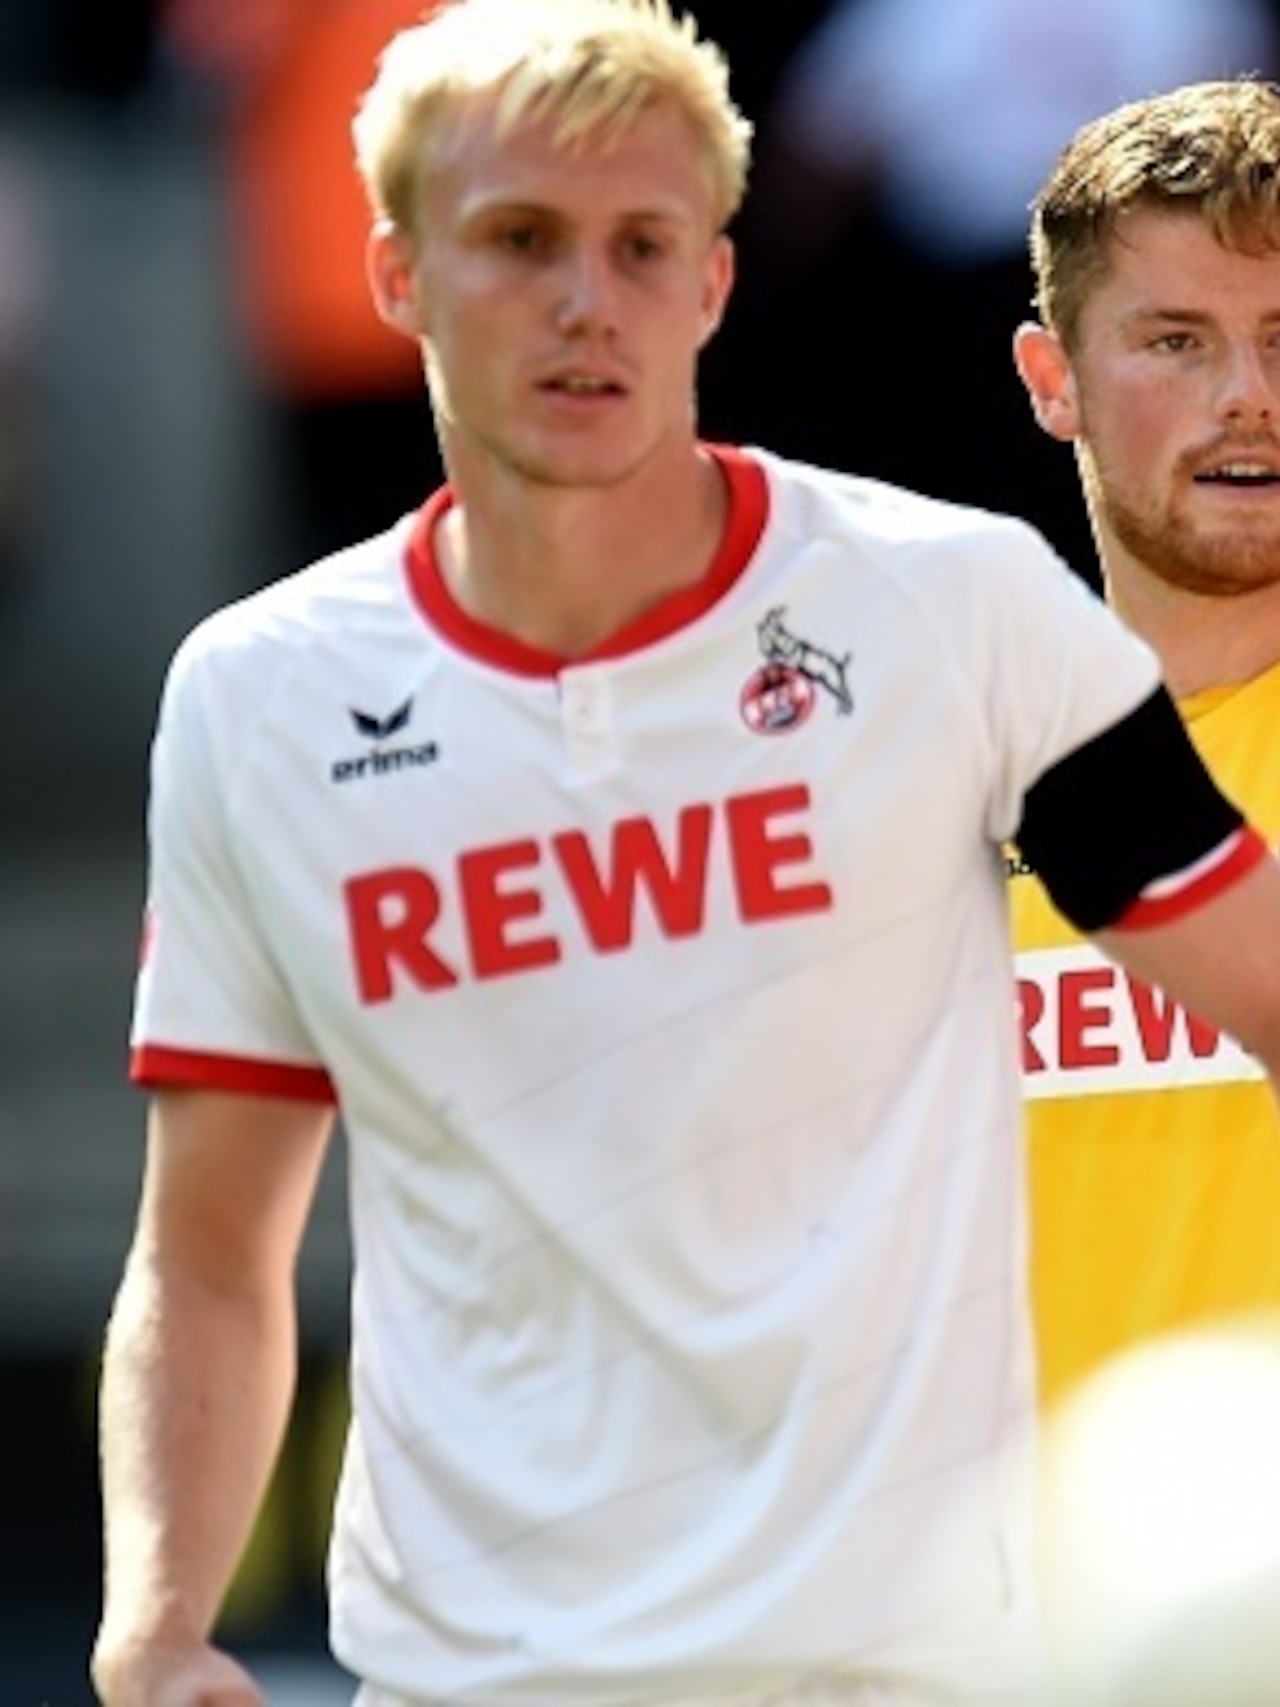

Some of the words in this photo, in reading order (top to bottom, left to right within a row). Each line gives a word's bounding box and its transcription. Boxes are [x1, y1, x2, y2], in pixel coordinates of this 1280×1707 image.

[331, 740, 438, 784] erima
[344, 784, 834, 1008] REWE
[1017, 967, 1221, 1074] REW
